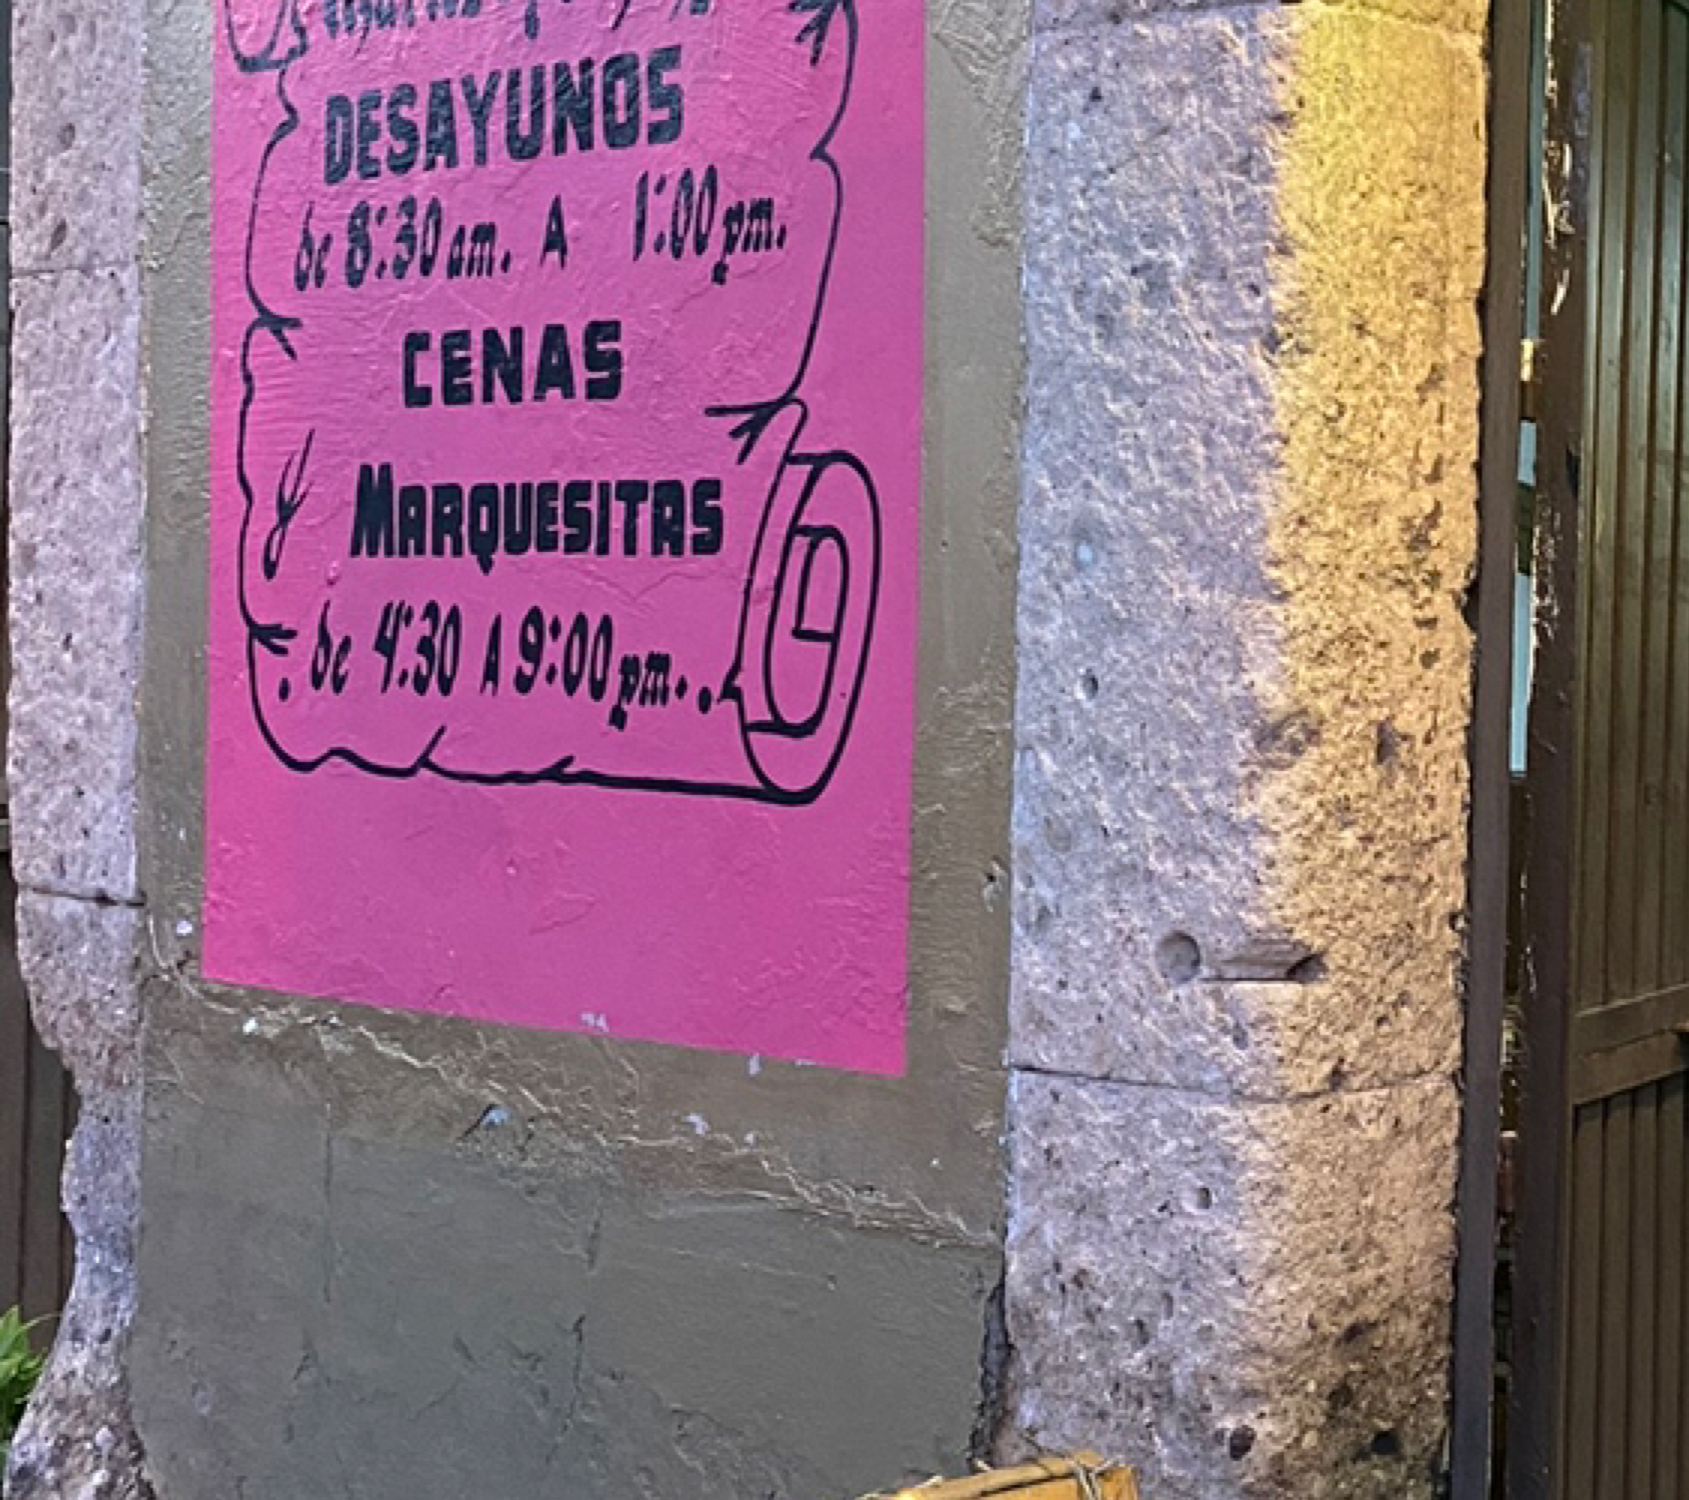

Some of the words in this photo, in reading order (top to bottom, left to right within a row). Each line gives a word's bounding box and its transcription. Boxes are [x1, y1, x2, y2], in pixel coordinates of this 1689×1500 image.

[323, 45, 684, 184] DESAYUNOS
[540, 195, 568, 269] A
[404, 320, 622, 408] CENAS
[374, 600, 461, 696] 4:30
[480, 612, 501, 695] A
